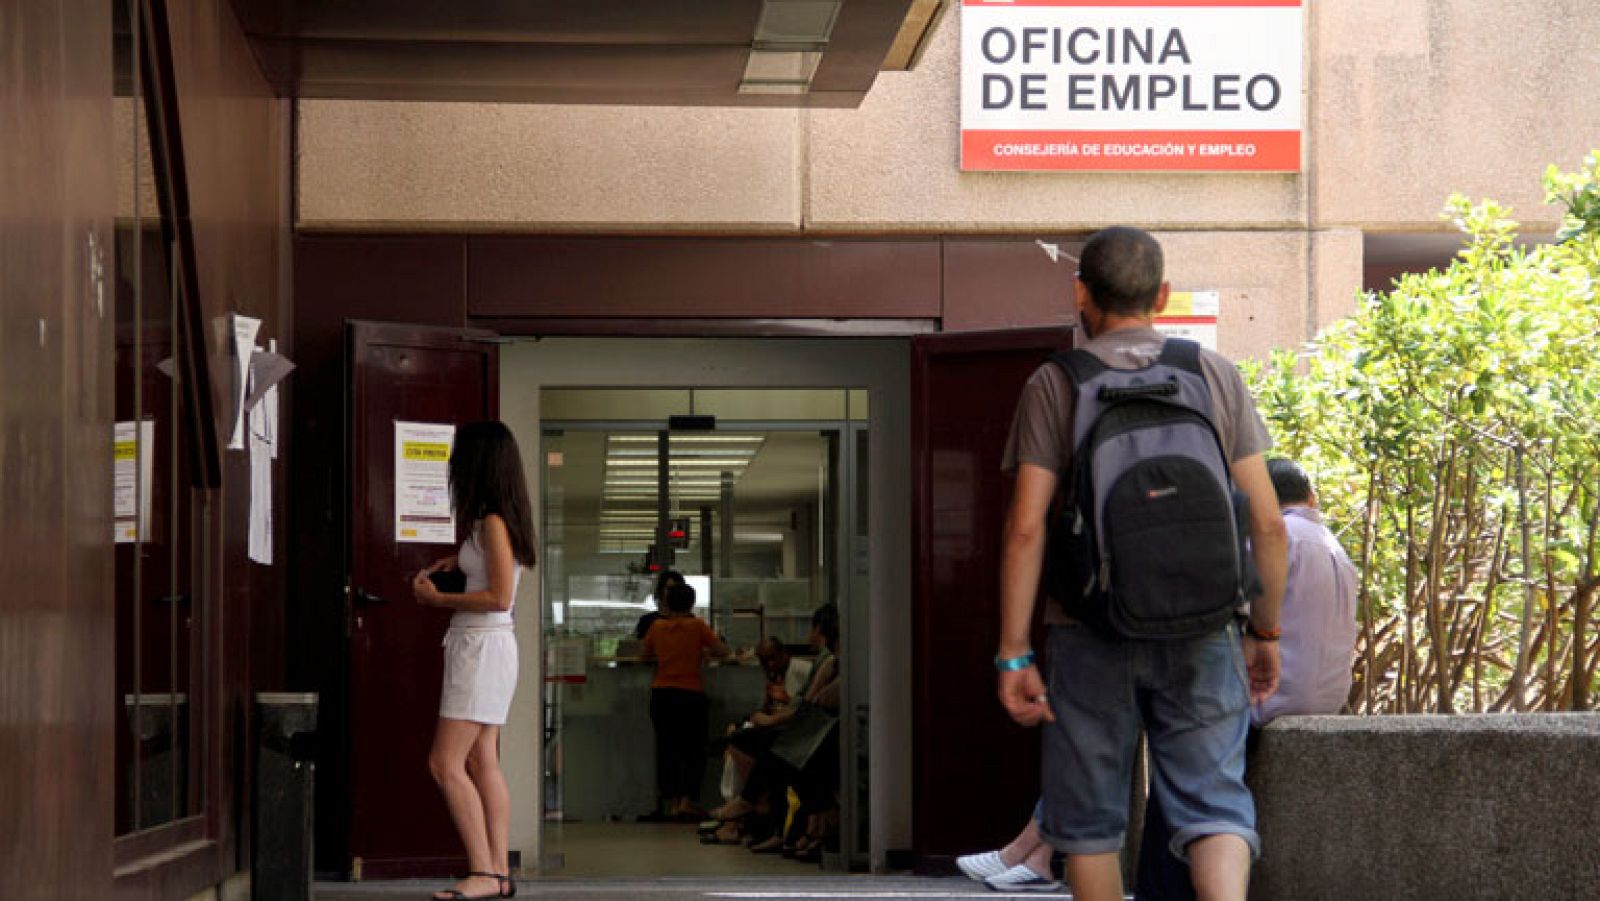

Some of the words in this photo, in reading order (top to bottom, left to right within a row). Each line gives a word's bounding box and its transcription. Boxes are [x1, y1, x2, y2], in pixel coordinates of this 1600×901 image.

[981, 27, 1191, 64] OFICINA
[982, 74, 1048, 111] DE
[1068, 74, 1281, 112] EMPLEO
[993, 140, 1078, 156] CONSEJERÍA
[1082, 143, 1101, 156] DE
[1103, 140, 1184, 156] EDUCACIÓN
[1187, 143, 1197, 156] Y
[1199, 143, 1256, 156] EMPLEO
